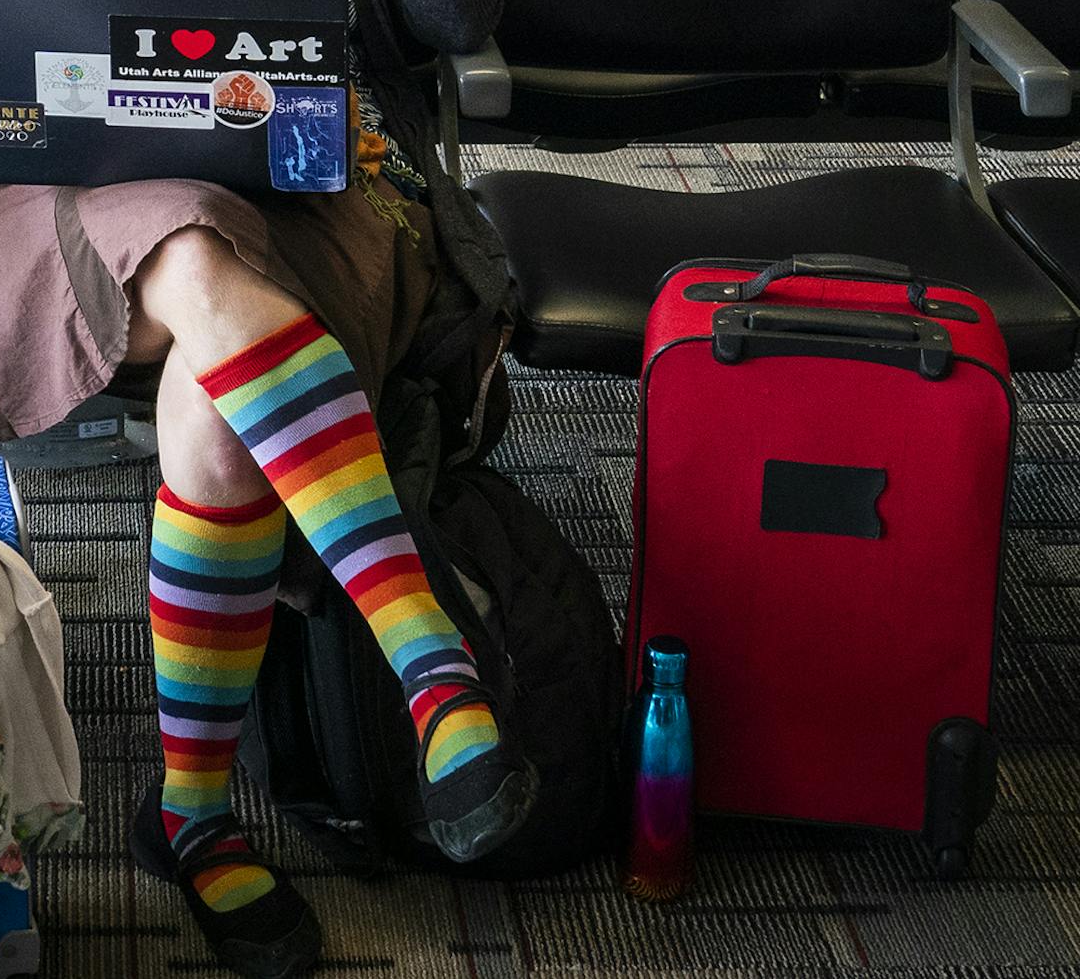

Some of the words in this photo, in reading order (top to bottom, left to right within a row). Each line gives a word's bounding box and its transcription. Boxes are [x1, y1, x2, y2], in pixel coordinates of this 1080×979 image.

[134, 28, 157, 58] I
[225, 31, 323, 62] Art
[118, 66, 150, 76] Utah
[152, 67, 180, 78] Arts
[255, 71, 338, 83] UtahArts.org
[114, 94, 201, 110] FESTIVAL
[129, 109, 189, 119] Playhouse
[216, 107, 264, 119] #DoJustice
